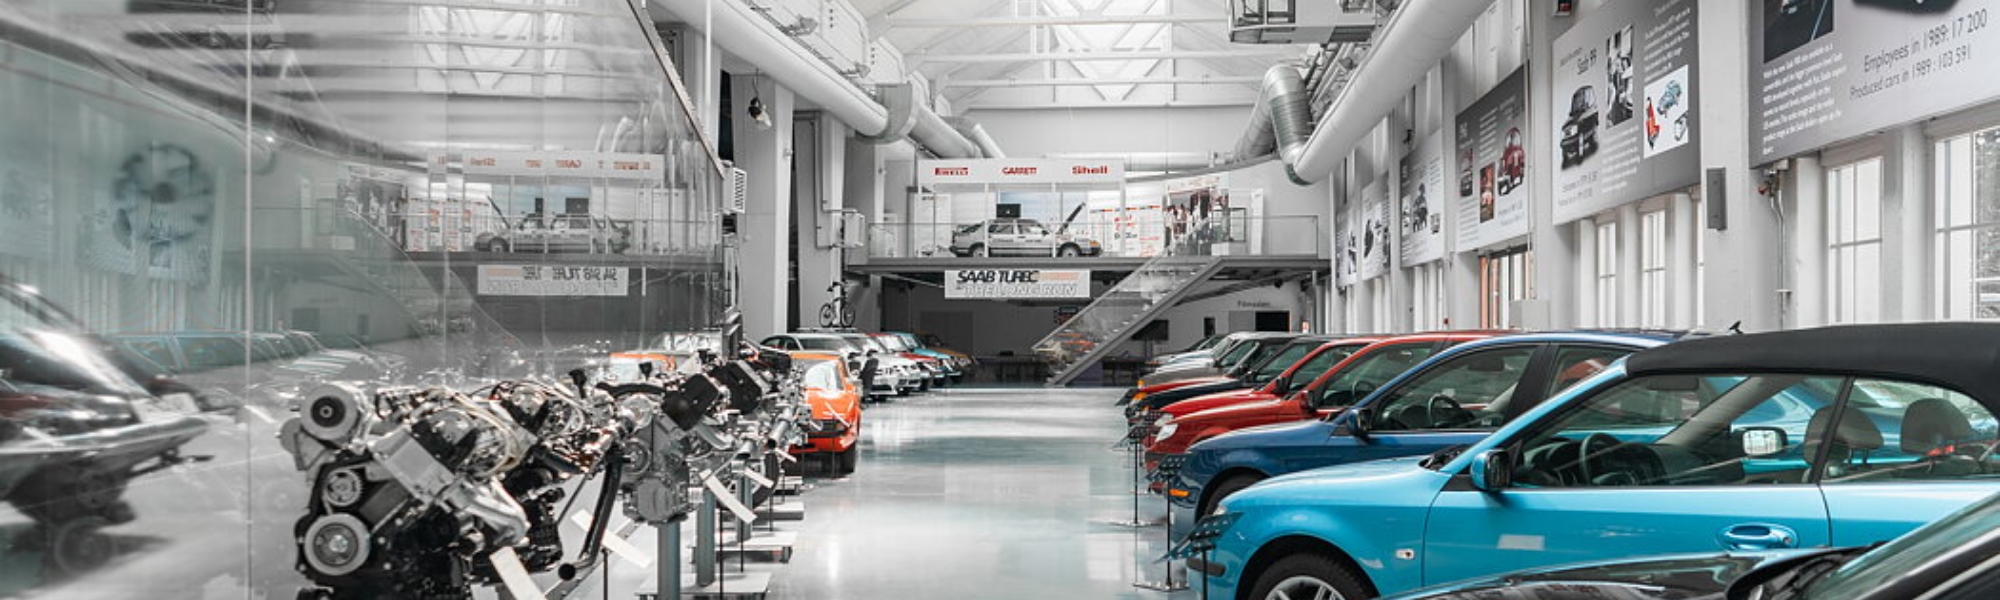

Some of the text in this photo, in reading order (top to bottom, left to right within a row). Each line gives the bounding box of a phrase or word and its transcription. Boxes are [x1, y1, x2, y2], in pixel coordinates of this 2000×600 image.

[1864, 45, 1909, 73] Employees
[1912, 37, 1920, 54] in
[1952, 17, 1964, 39] 17
[1967, 8, 1987, 34] 200
[1850, 79, 1883, 100] Produced
[1885, 75, 1900, 89] cars
[1902, 69, 1909, 82] in
[1938, 51, 1953, 70] 103
[1955, 43, 1971, 64] 591
[1072, 165, 1108, 175] Shell
[956, 270, 995, 283] SAAB
[964, 284, 993, 296] THE
[1042, 284, 1078, 296] RUN
